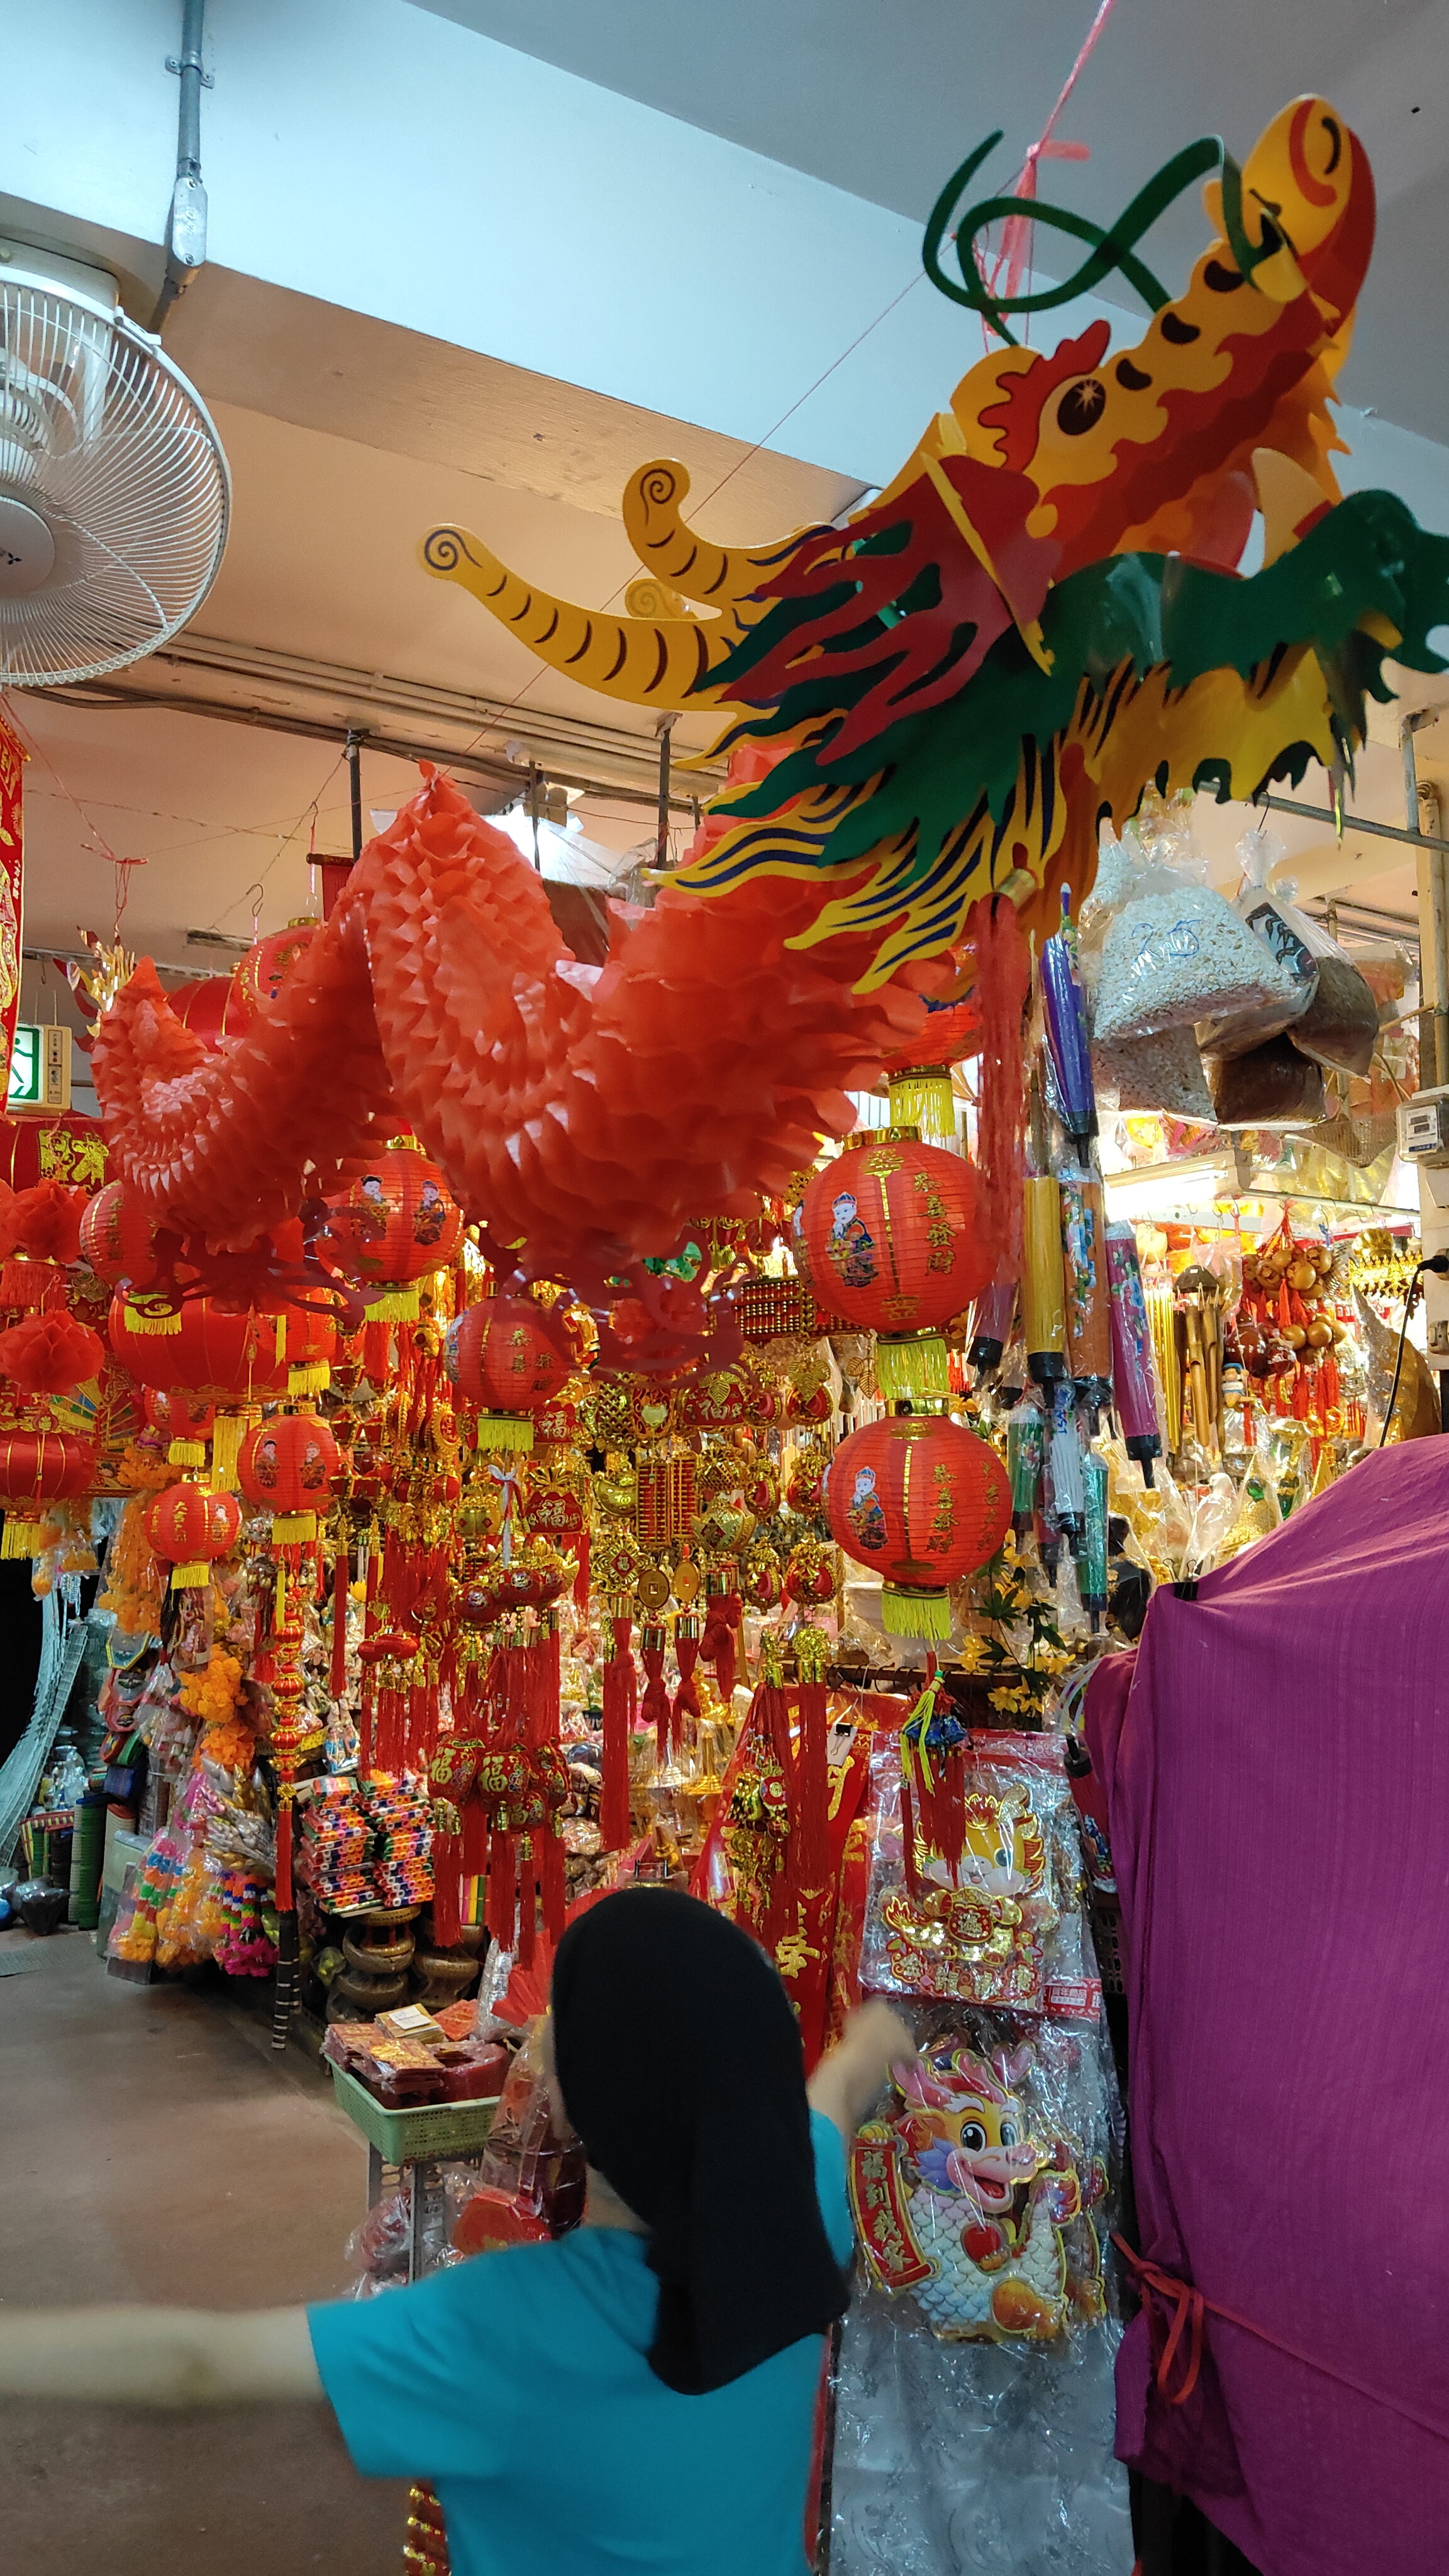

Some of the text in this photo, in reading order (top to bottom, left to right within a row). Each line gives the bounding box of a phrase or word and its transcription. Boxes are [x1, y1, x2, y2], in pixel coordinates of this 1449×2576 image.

[913, 1172, 958, 1275] 恭喜發財
[538, 1411, 569, 1440] 福
[536, 1499, 568, 1528] 福
[431, 1746, 457, 1785] 福
[480, 1755, 508, 1792] 福
[861, 2150, 914, 2272] 福到我家
